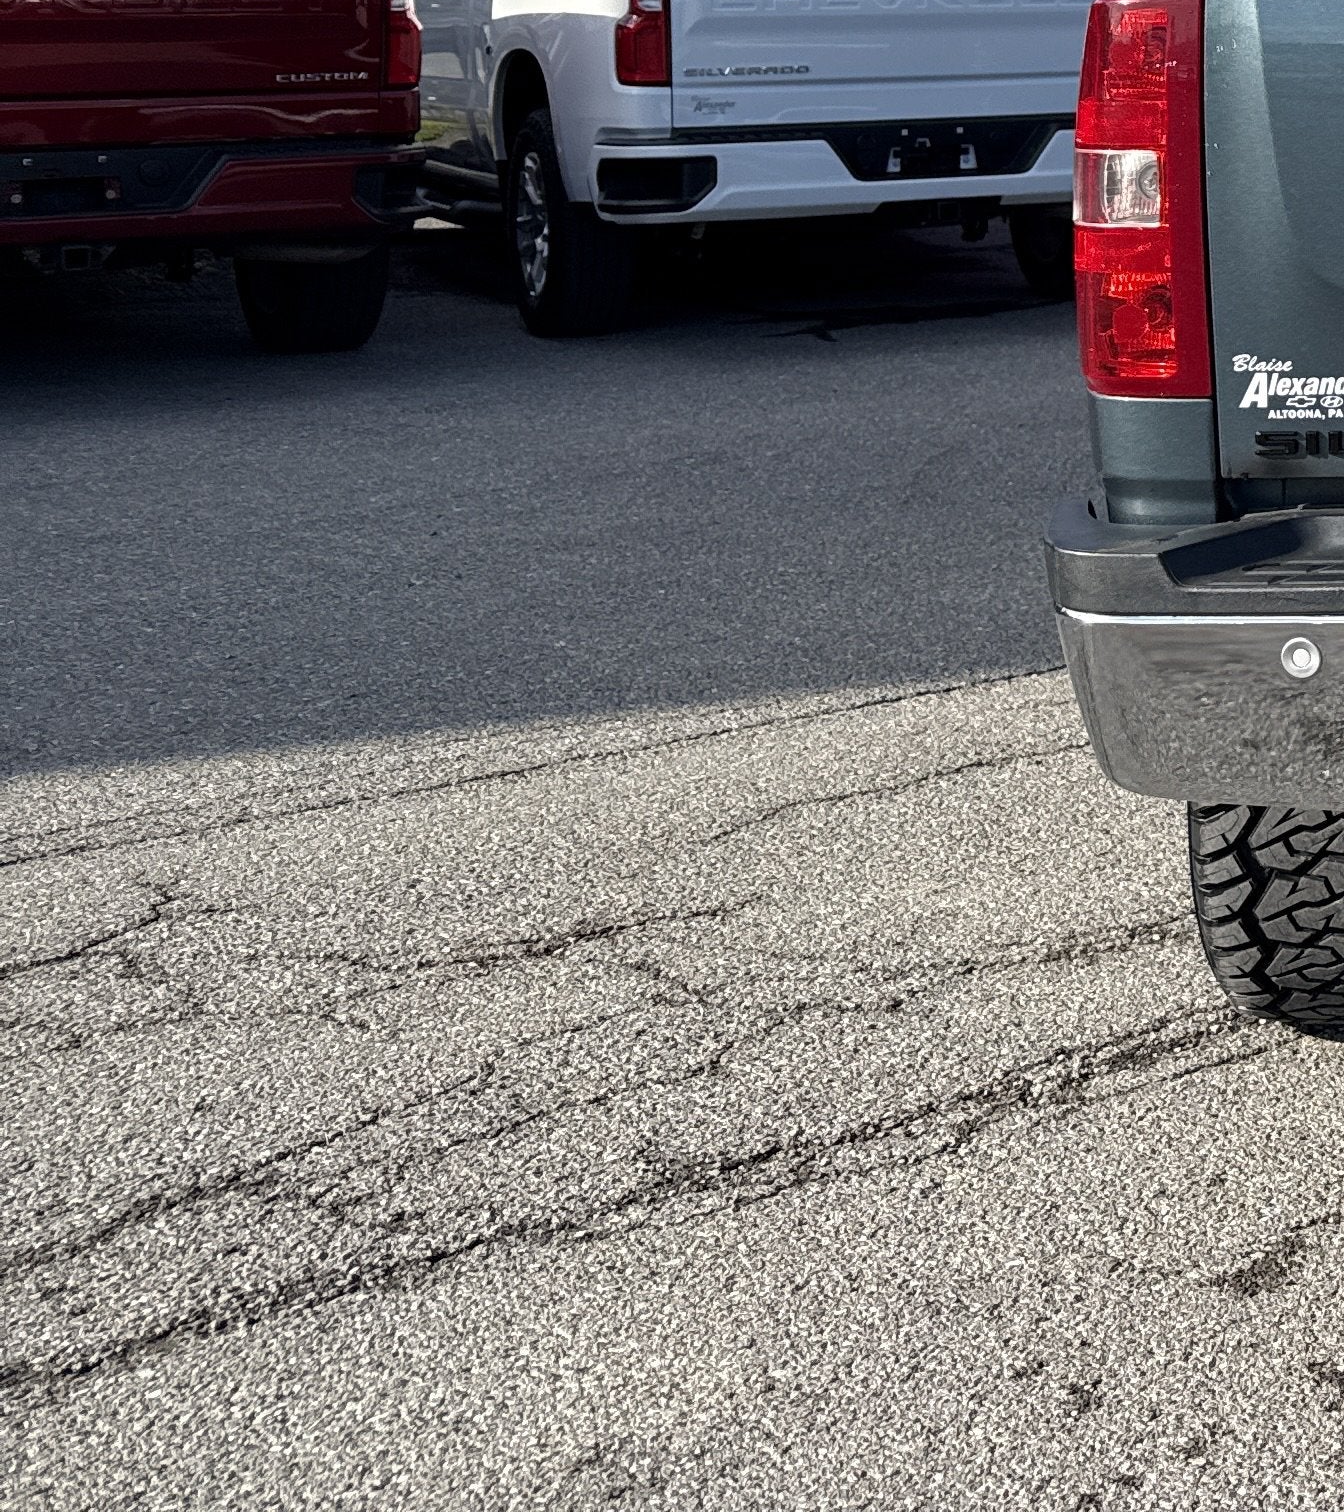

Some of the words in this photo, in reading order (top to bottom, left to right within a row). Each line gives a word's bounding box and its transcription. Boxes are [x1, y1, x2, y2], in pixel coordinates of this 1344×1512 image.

[275, 71, 370, 82] CUSTOM
[683, 65, 810, 77] SILVERADO
[1232, 354, 1293, 372] Blaise
[1268, 409, 1326, 420] ALTOONA,
[1327, 409, 1344, 419] PA
